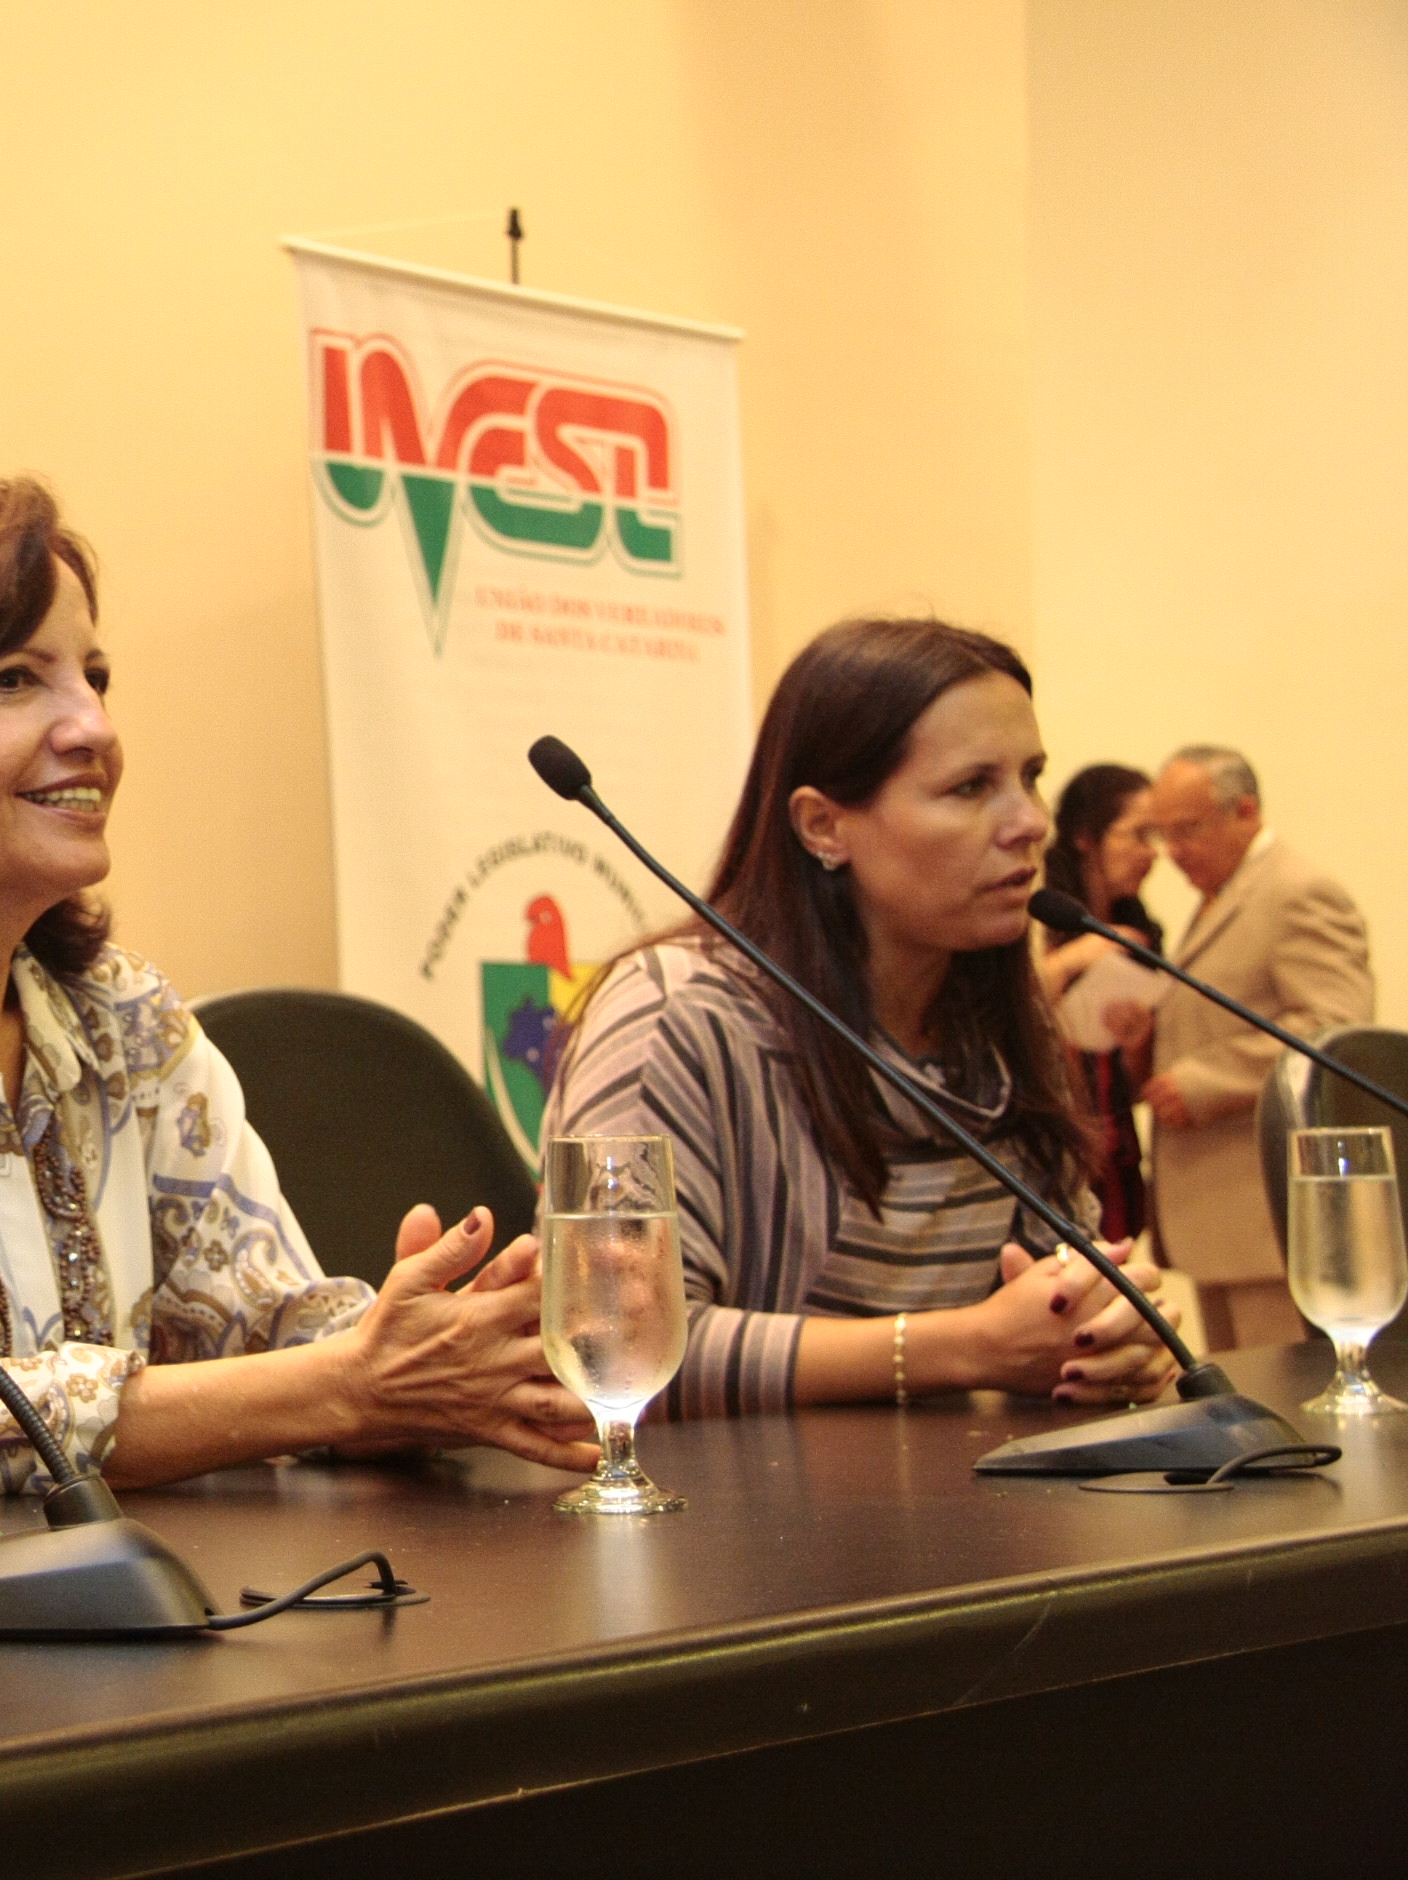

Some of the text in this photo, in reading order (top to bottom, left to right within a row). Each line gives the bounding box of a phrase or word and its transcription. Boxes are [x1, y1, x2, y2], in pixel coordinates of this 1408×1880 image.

[475, 585, 543, 615] UNIÃO
[547, 595, 592, 618] DOS
[495, 619, 523, 642] DE
[529, 625, 596, 650] SANTA
[420, 886, 468, 981] PODER
[467, 832, 587, 888] LEGISLATIVO
